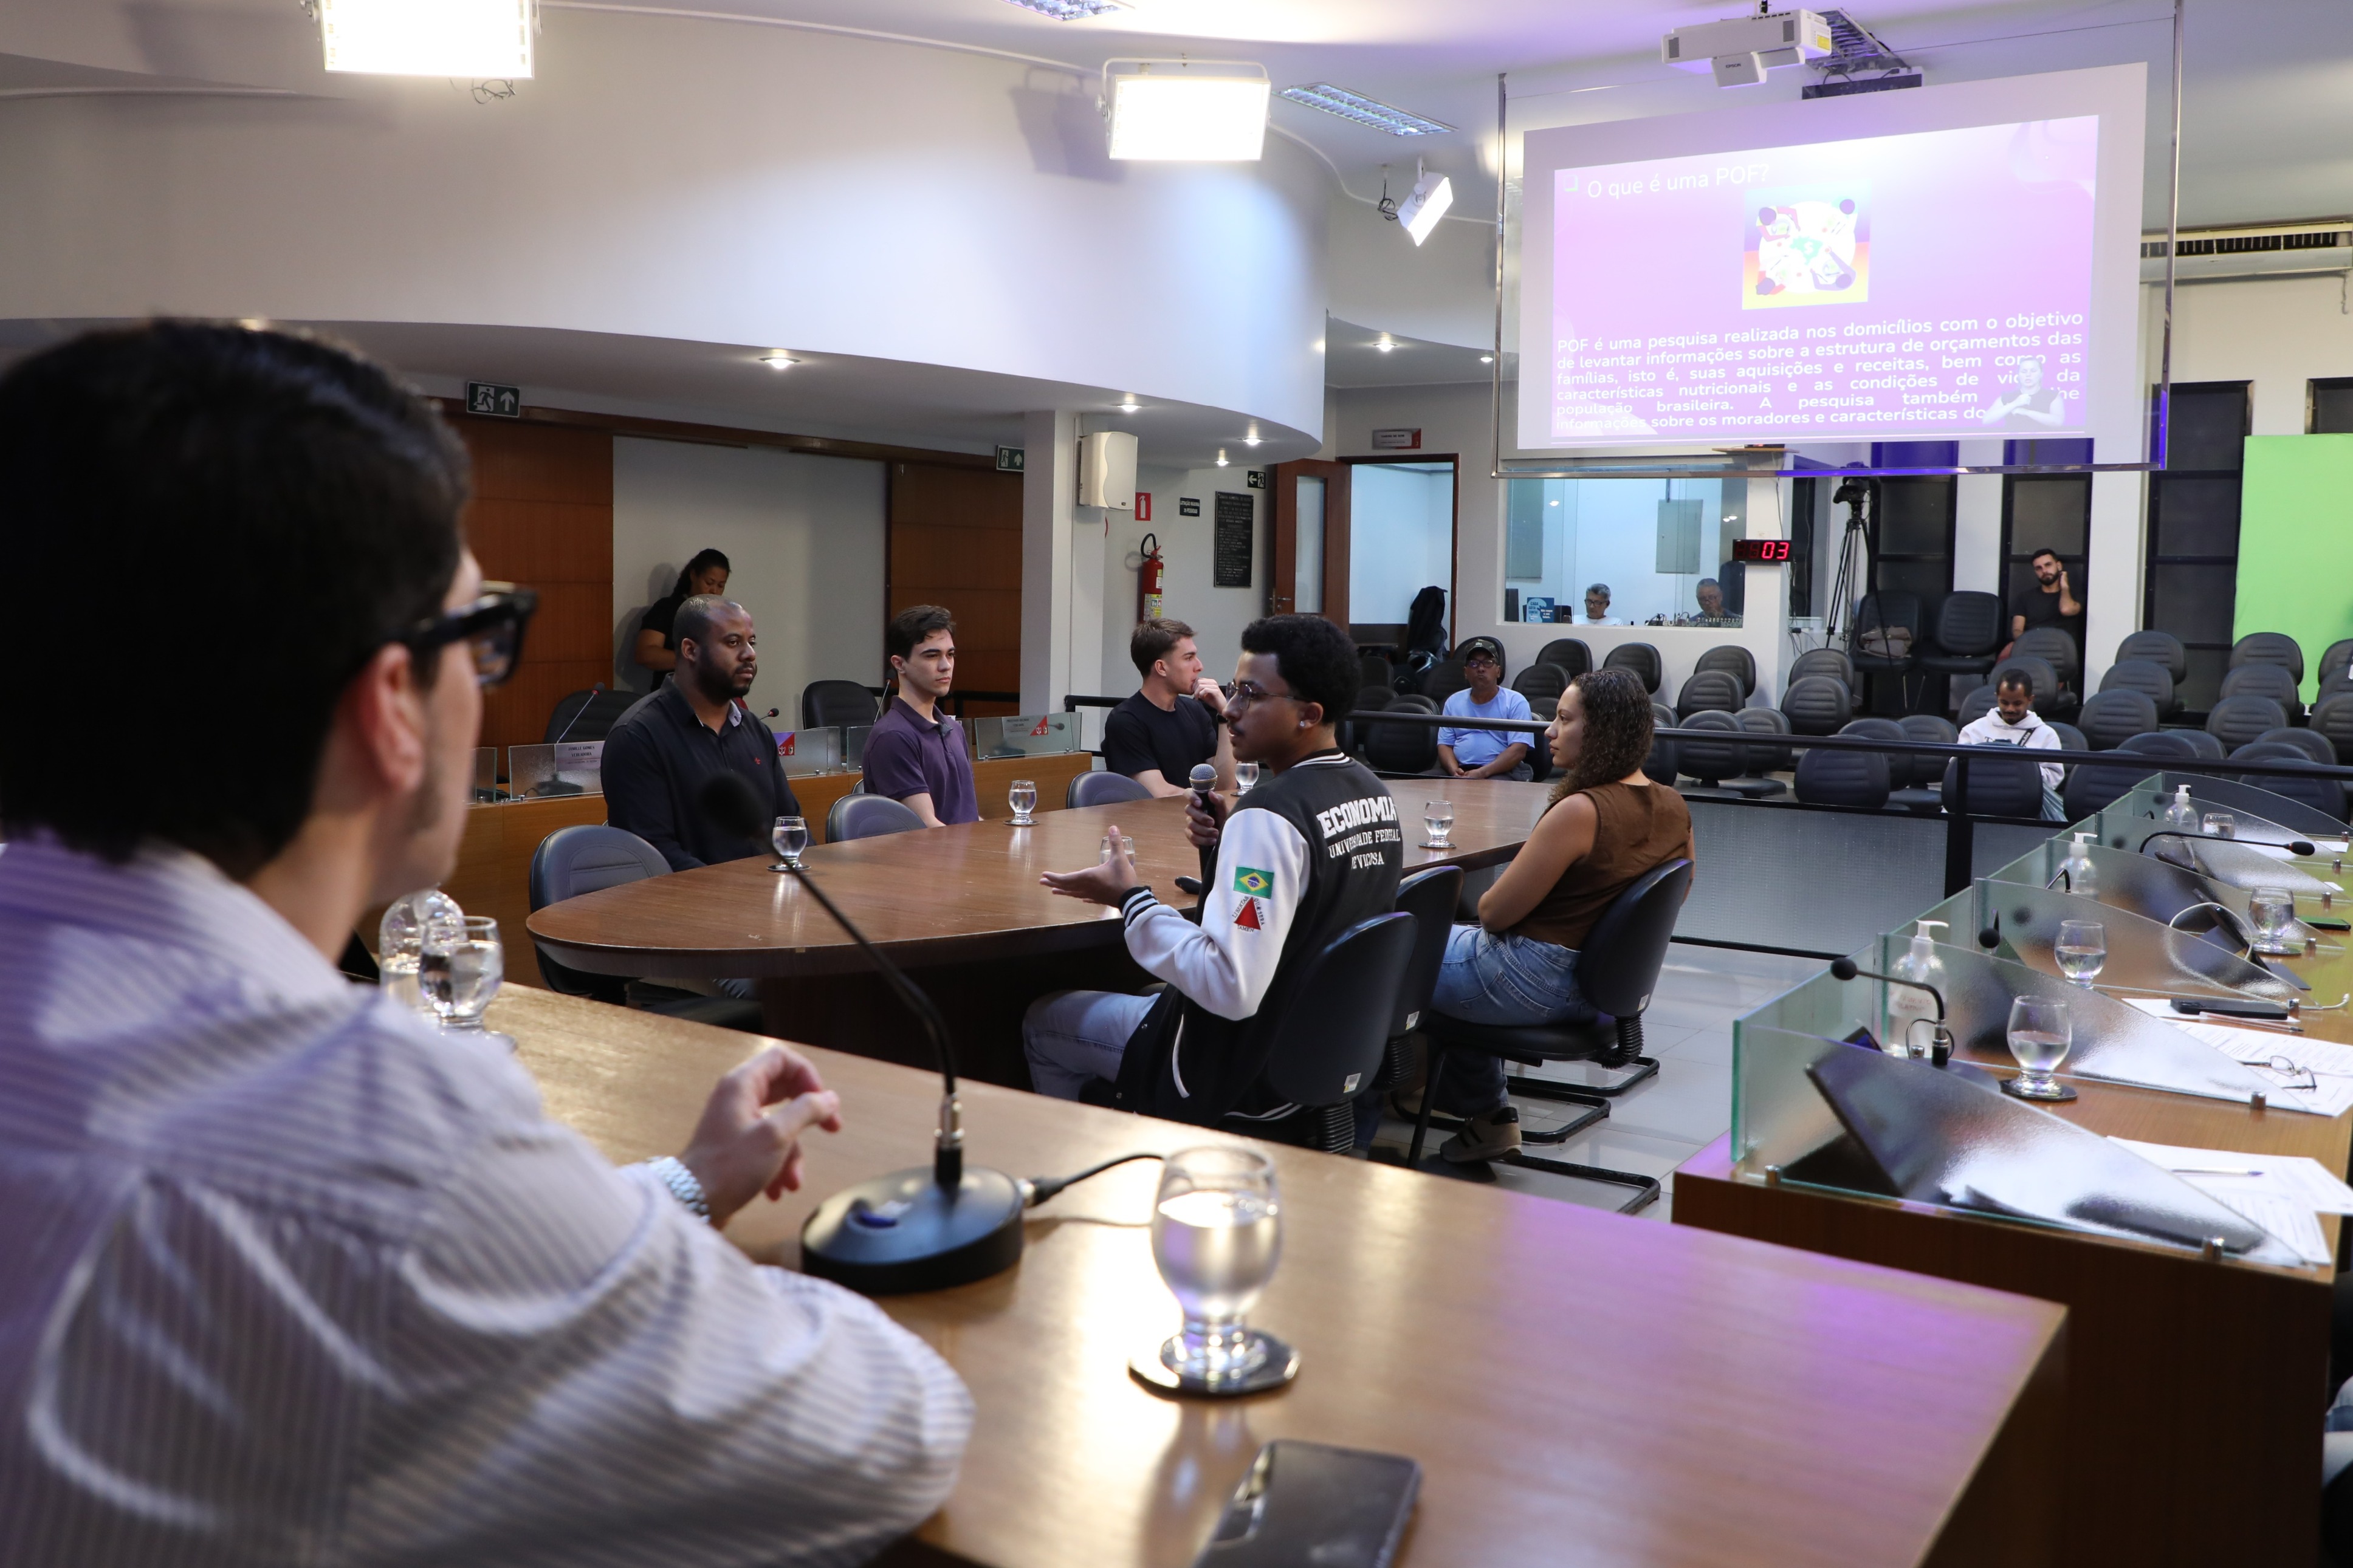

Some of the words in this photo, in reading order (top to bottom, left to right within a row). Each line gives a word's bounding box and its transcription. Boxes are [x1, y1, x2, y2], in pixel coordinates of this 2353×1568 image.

[1587, 180, 1602, 198] O
[1608, 181, 1643, 199] que
[1649, 173, 1661, 192] é
[1667, 174, 1709, 190] uma
[1716, 163, 1770, 186] POF?
[1557, 338, 1589, 352] POF
[1594, 337, 1603, 351] é
[1609, 338, 1641, 350] uma
[1647, 331, 1718, 350] pesquisa
[1724, 326, 1799, 343] realizada
[1806, 327, 1836, 339] nos
[1843, 318, 1932, 338] domicílios
[1940, 319, 1978, 332] com
[1986, 318, 1997, 329] o
[2005, 311, 2083, 330] objetivo
[1557, 357, 1575, 369] de
[1579, 355, 1641, 369] levantar
[1646, 347, 1743, 365] informações
[1748, 345, 1794, 359] sobre
[1800, 346, 1810, 357] a
[1815, 341, 1895, 356] estrutura
[1901, 338, 1923, 352] de
[1929, 332, 2041, 353] orçamentos
[2047, 331, 2082, 345] das
[1556, 386, 1663, 400] características
[1678, 380, 1771, 397] nutricionais
[1787, 381, 1798, 392] e
[1814, 380, 1833, 391] as
[1849, 374, 1937, 391] condições
[1956, 372, 1979, 386] de
[2056, 368, 2080, 382] da
[1557, 369, 1619, 385] famílias,
[1628, 369, 1656, 382] isto
[1666, 367, 1679, 382] é,
[1689, 367, 1726, 380] suas
[1736, 360, 1822, 379] aquisições
[1833, 362, 1844, 373] e
[1855, 357, 1929, 372] receitas,
[1942, 354, 1981, 368] bem
[1994, 354, 2046, 366] coo
[2059, 352, 2081, 364] as
[1556, 402, 1633, 417] população
[1657, 399, 1734, 413] brasileira.
[1759, 397, 1772, 408] A
[1798, 394, 1874, 411] pesquisa
[1902, 389, 1978, 405] também
[1556, 417, 1646, 431] informações
[1651, 415, 1694, 428] sobre
[1699, 416, 1717, 426] os
[1722, 412, 1810, 426] moradores
[1815, 412, 1826, 423] e
[1830, 406, 1957, 423] características
[1761, 541, 1790, 559] 03
[1316, 796, 1398, 839] ECONOMIA
[1232, 895, 1249, 918] LIBERTAS
